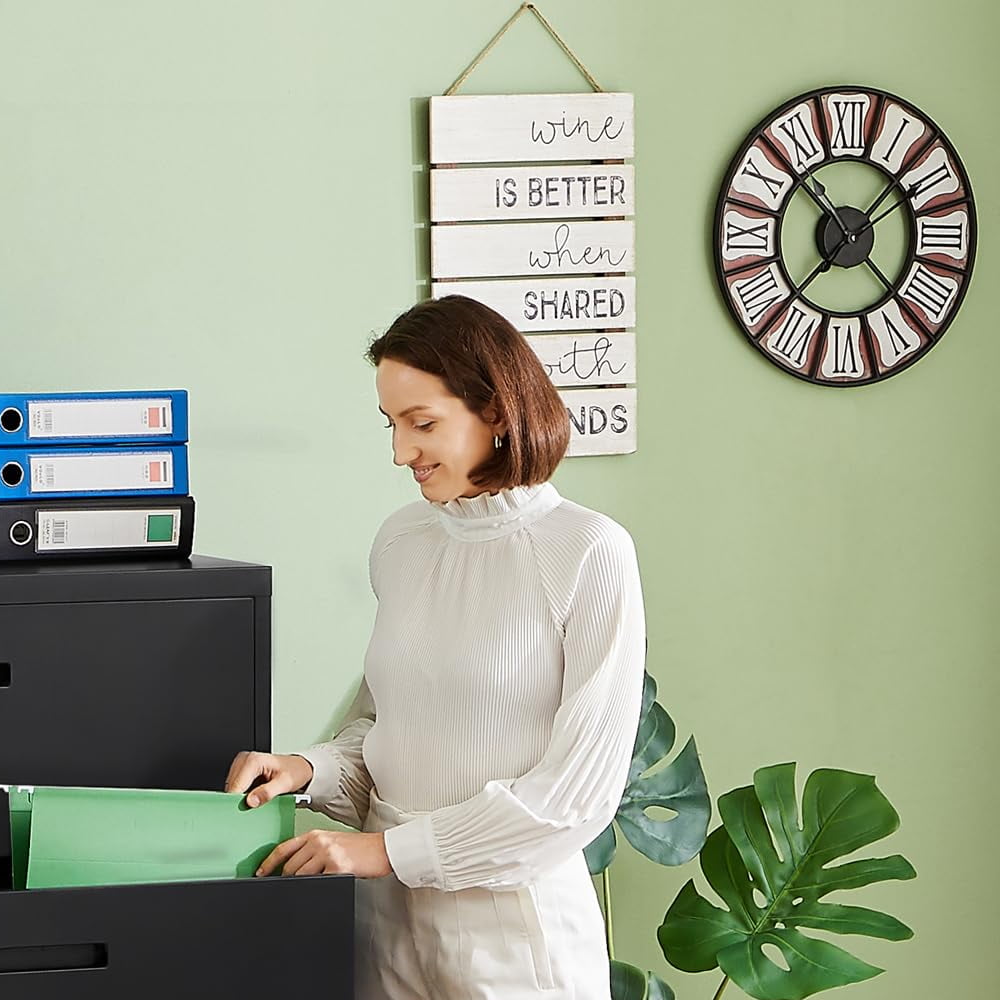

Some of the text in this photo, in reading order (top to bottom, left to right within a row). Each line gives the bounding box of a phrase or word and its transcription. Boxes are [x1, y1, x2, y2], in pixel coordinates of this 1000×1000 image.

[531, 111, 625, 144] wine
[778, 112, 820, 166] XI
[832, 101, 865, 149] XII
[882, 118, 910, 163] I
[496, 175, 626, 208] IS BETTER
[742, 158, 784, 198] X
[529, 224, 627, 269] when
[727, 222, 769, 252] IX
[921, 222, 962, 250] III
[523, 289, 626, 320] SHARED
[771, 306, 816, 365] VII
[832, 325, 858, 373] VI
[881, 310, 911, 356] V
[567, 405, 628, 435] NDS
